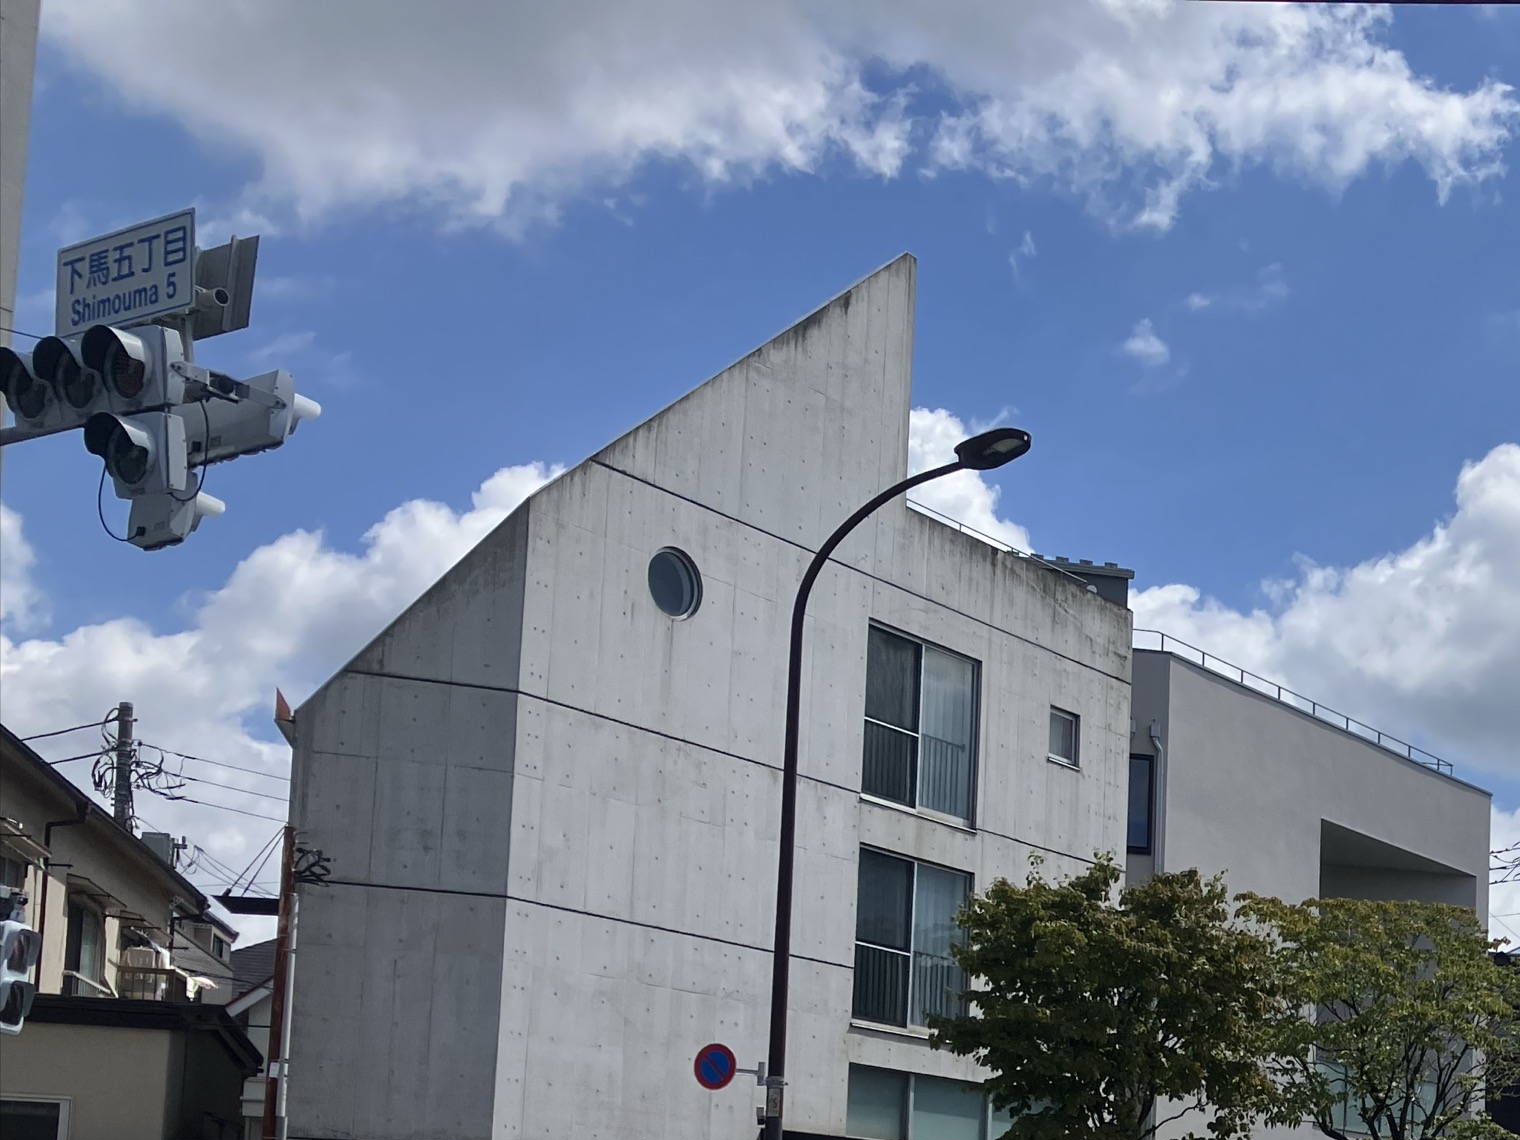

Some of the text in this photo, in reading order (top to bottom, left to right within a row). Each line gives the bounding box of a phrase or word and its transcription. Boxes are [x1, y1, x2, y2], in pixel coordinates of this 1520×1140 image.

[63, 225, 186, 295] 下馬五丁目
[71, 272, 176, 326] Shimouma 5
